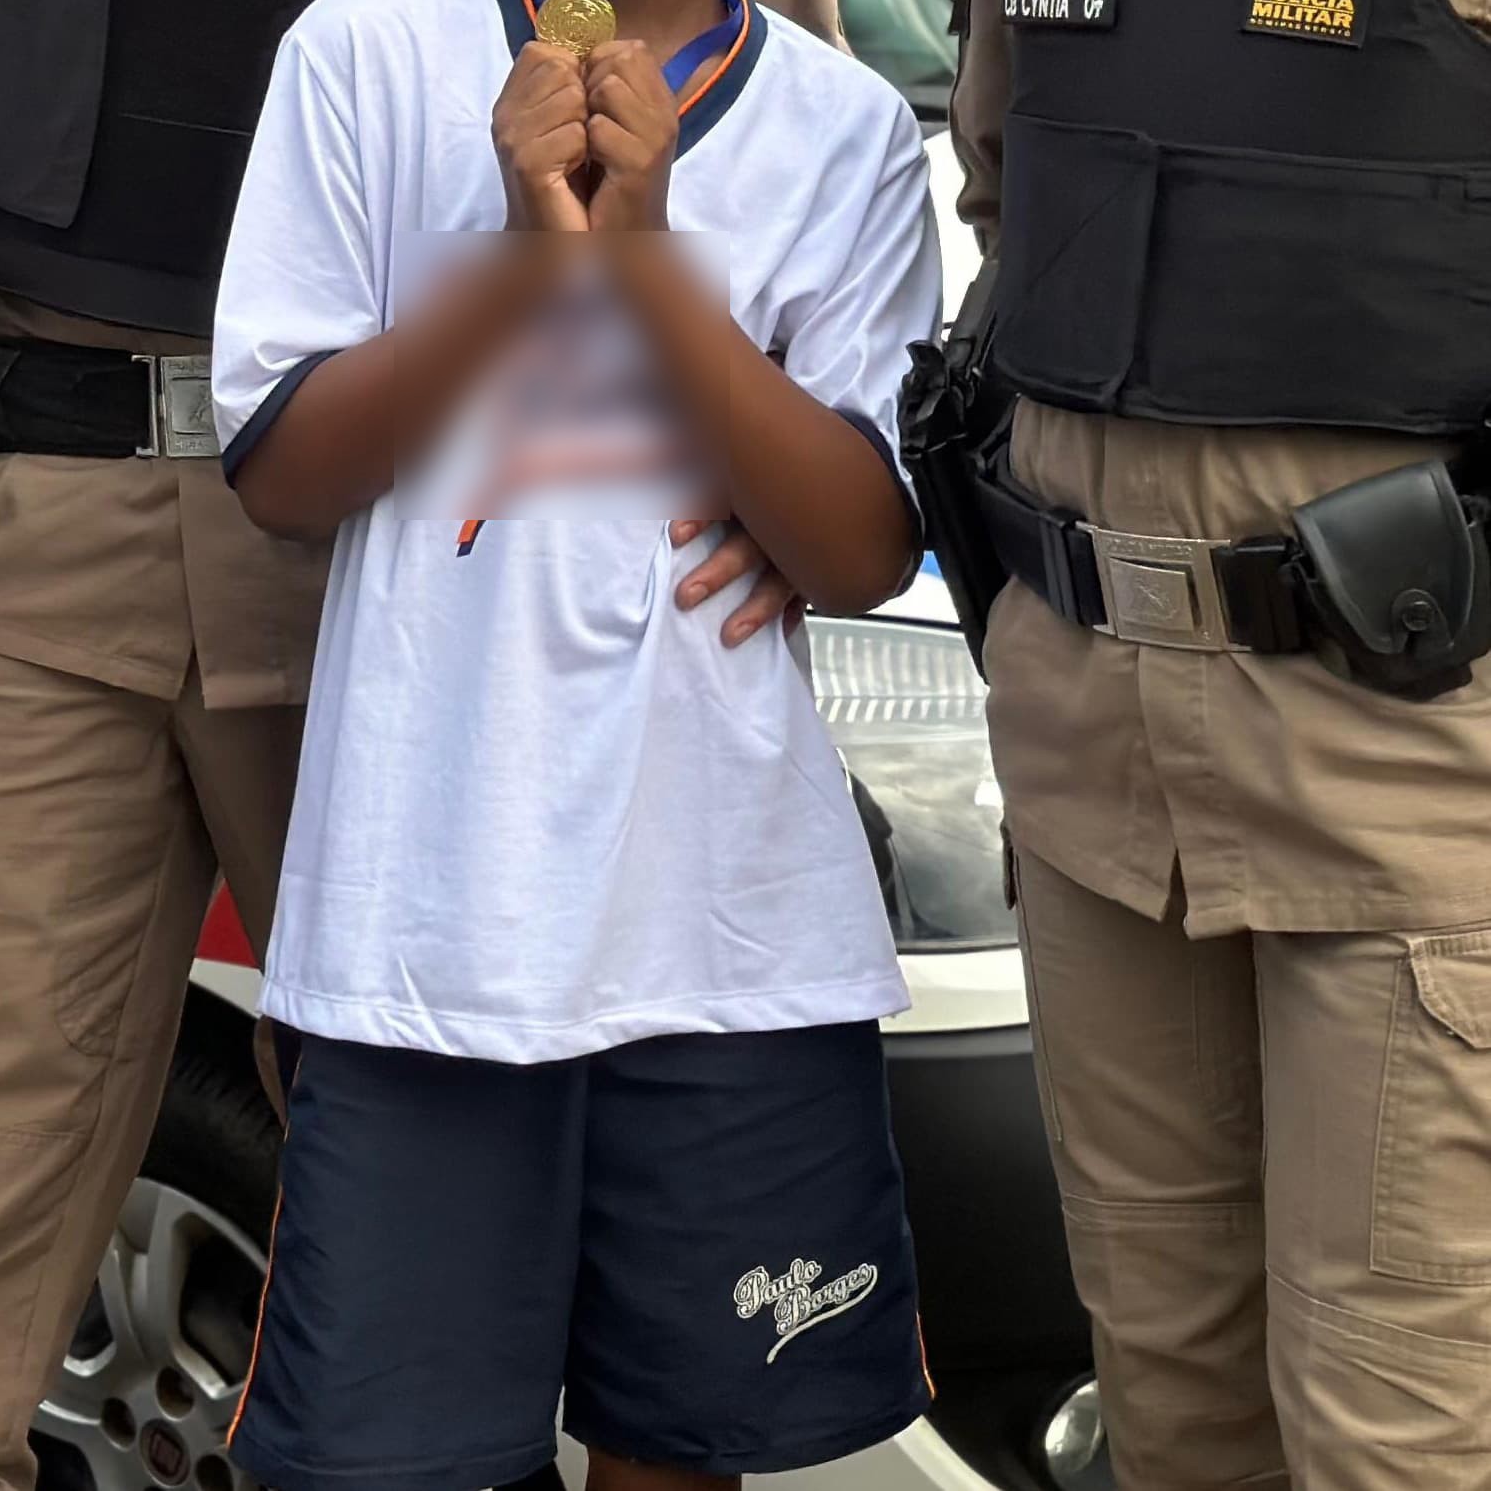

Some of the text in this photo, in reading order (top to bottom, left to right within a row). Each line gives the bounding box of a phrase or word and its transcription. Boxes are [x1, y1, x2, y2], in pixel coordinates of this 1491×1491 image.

[1252, 3, 1354, 28] MILITAR
[733, 1258, 822, 1319] Paulo
[774, 1262, 873, 1335] Borges
